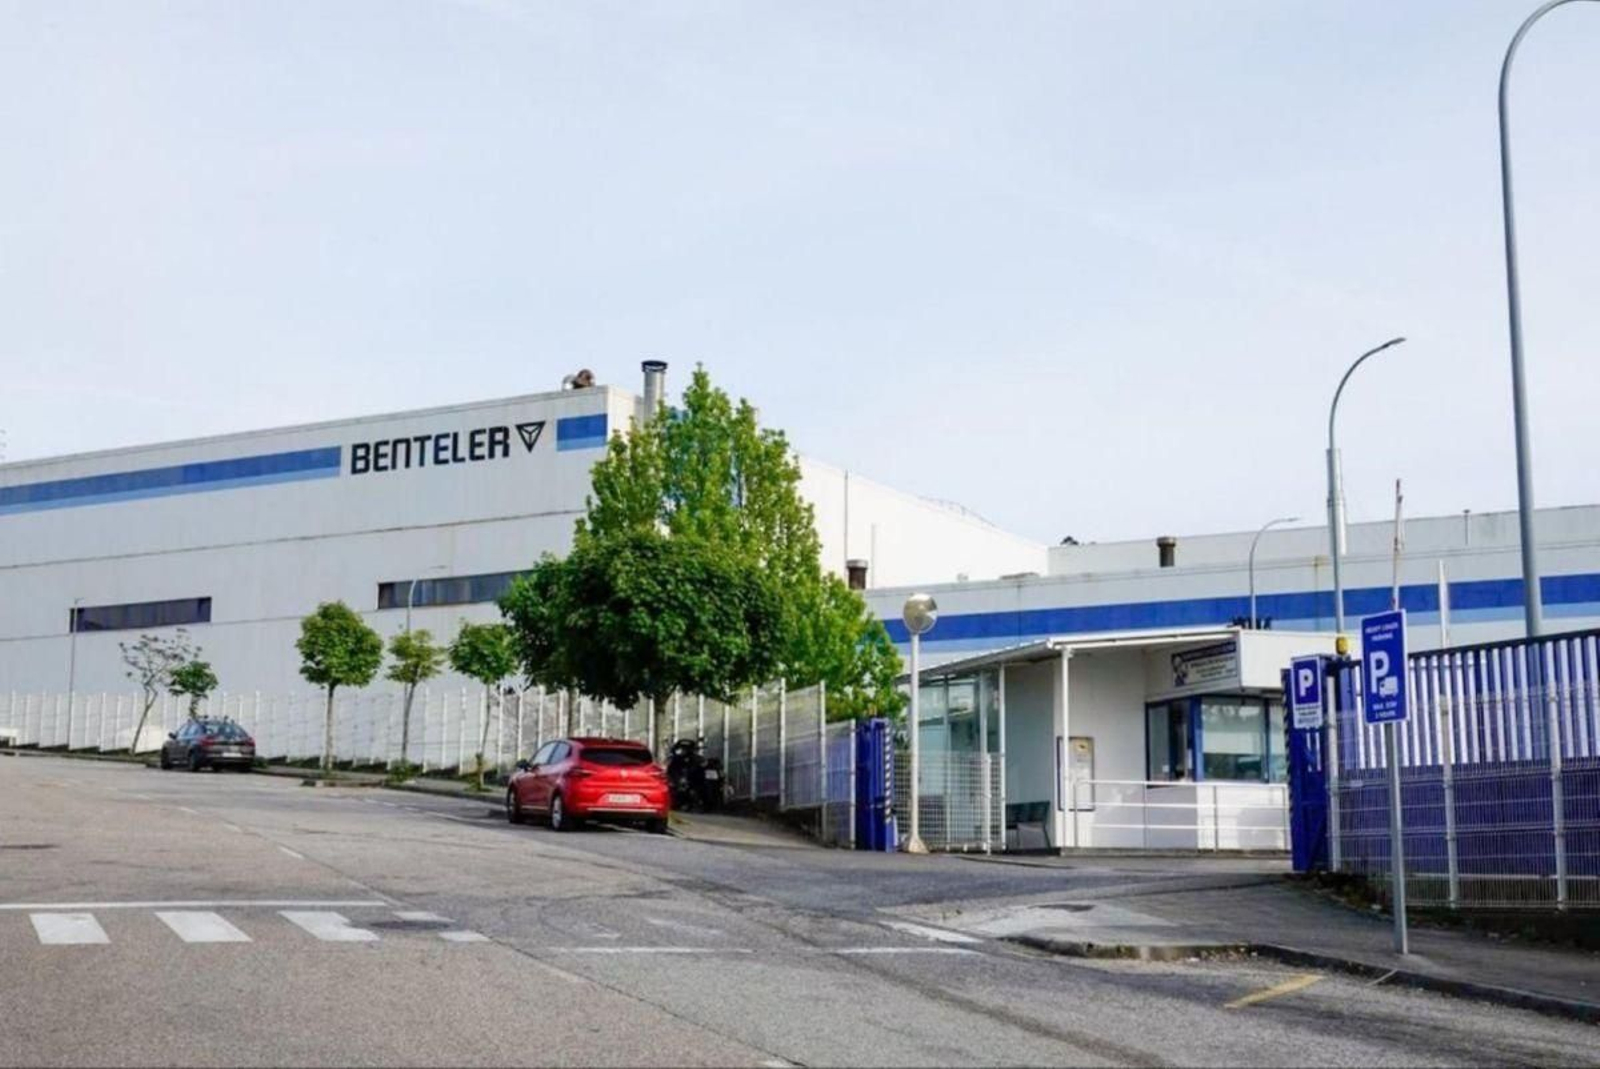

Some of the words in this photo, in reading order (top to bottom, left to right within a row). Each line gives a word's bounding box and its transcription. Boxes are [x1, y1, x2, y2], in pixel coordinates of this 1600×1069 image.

[351, 426, 510, 474] BENTELER
[1299, 668, 1313, 696] P
[1370, 650, 1389, 693] P
